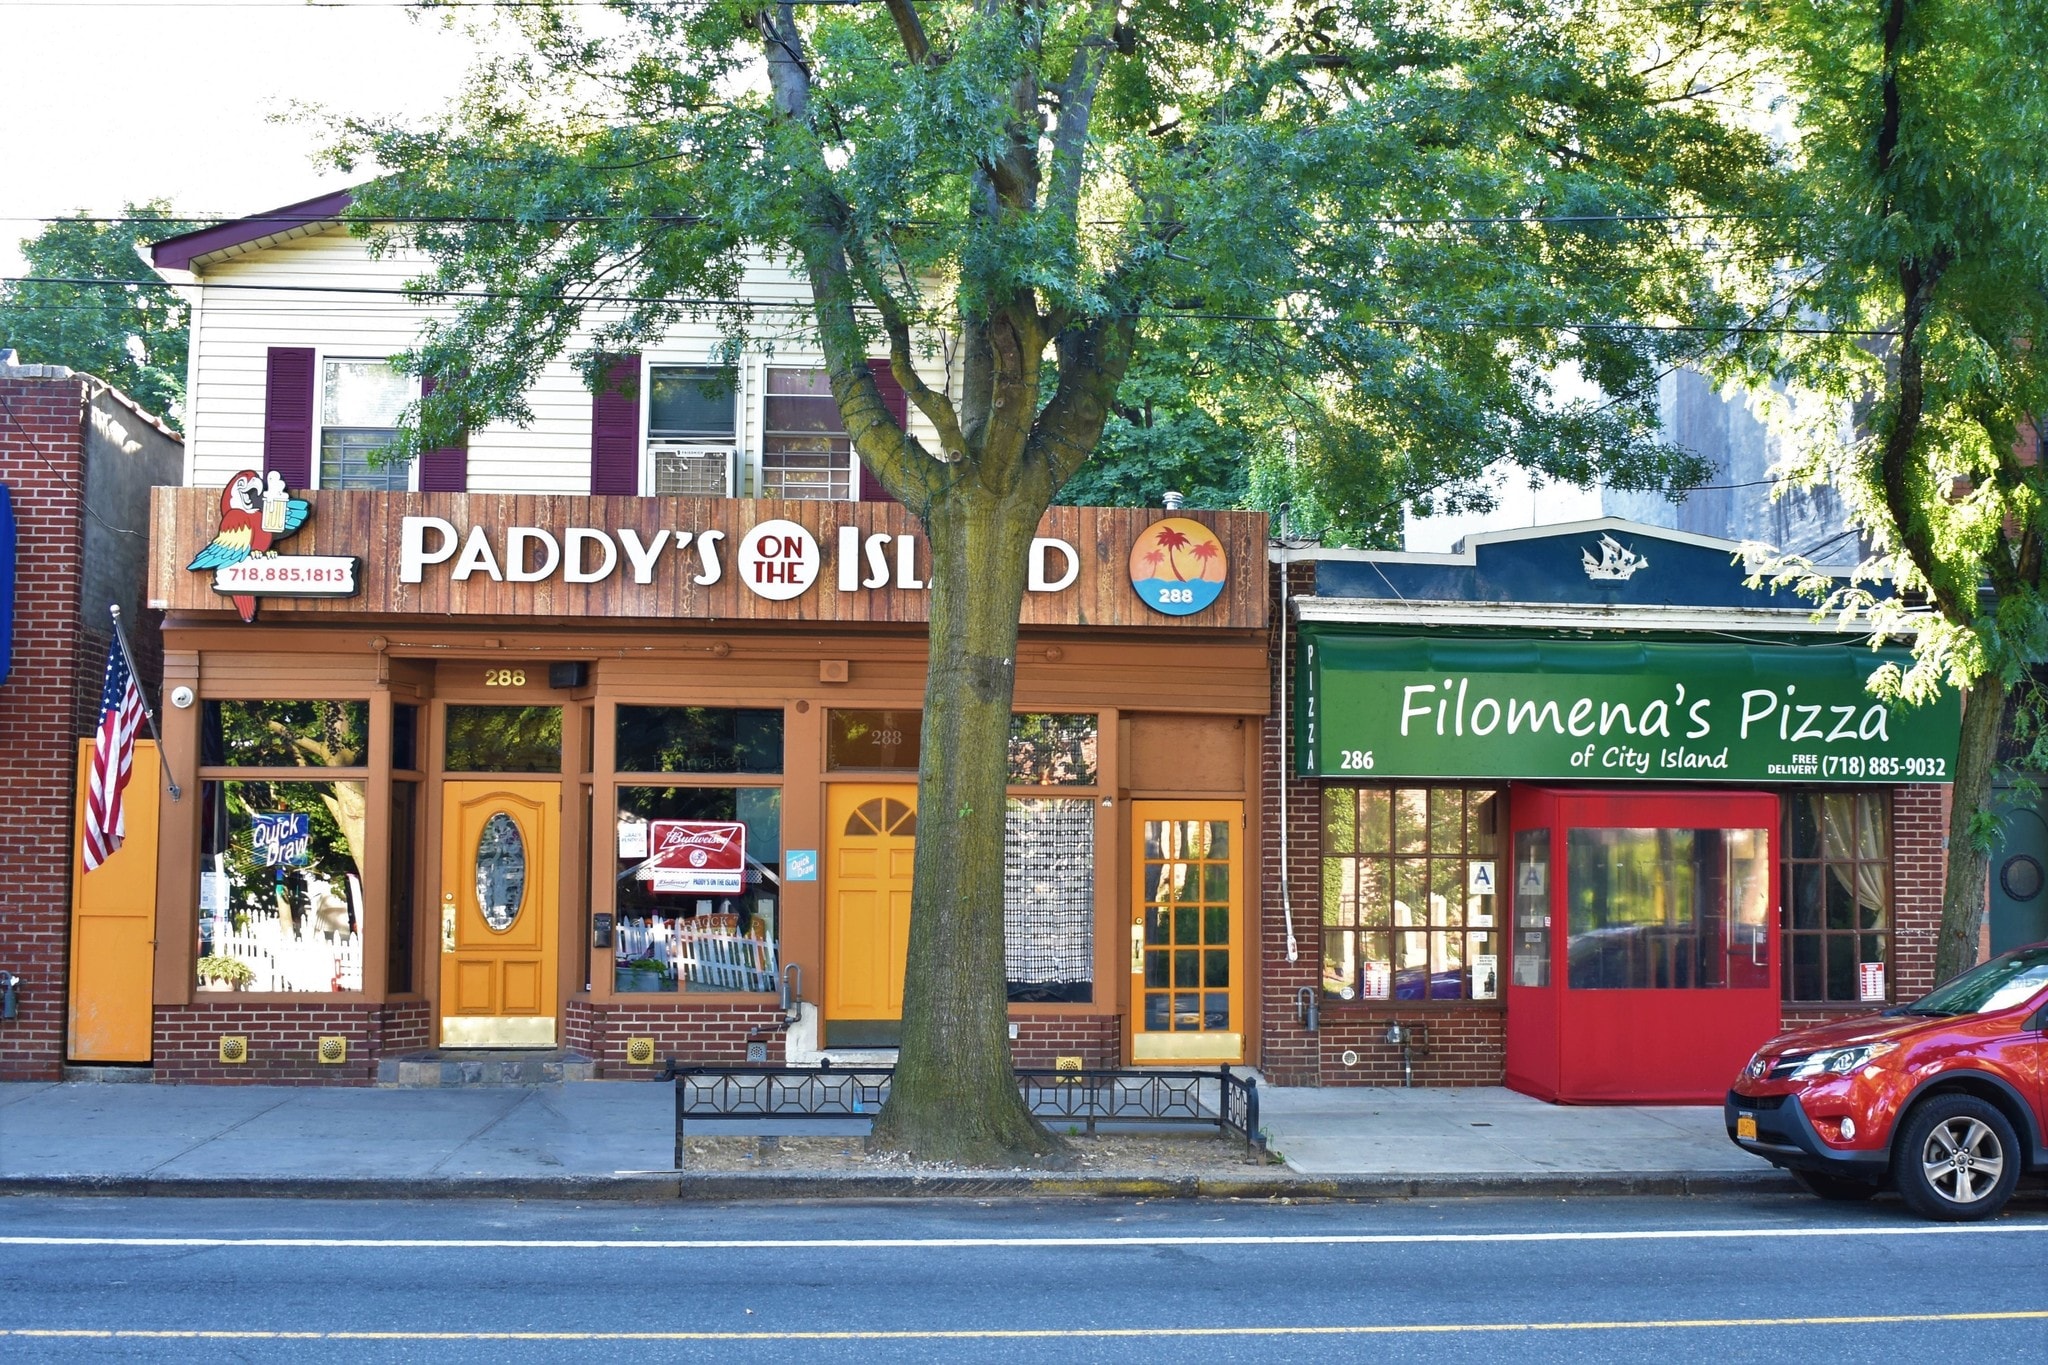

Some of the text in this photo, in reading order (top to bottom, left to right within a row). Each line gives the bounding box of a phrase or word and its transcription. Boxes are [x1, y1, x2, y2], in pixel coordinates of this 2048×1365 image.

[400, 516, 726, 587] PADDY'S
[756, 535, 803, 559] ON
[838, 526, 1080, 592] ISLD
[229, 567, 345, 583] 718.885.1813
[753, 560, 805, 585] THE
[1159, 588, 1194, 604] 288
[485, 668, 526, 687] 288
[1306, 644, 1315, 770] PIZZA
[1400, 677, 1890, 743] Filomena's Pizza
[871, 730, 902, 745] 288
[1340, 750, 1374, 770] 286
[1570, 743, 1729, 774] of City Island
[1792, 754, 1818, 765] FREE
[1822, 755, 1946, 778] (718) 885-9032
[1768, 764, 1818, 775] DELIVERY
[253, 813, 300, 848] Quick
[666, 831, 729, 847] Budweiser
[266, 835, 309, 867] Draw
[791, 855, 810, 871] Quick
[797, 863, 814, 878] Draw
[1474, 866, 1491, 885] A
